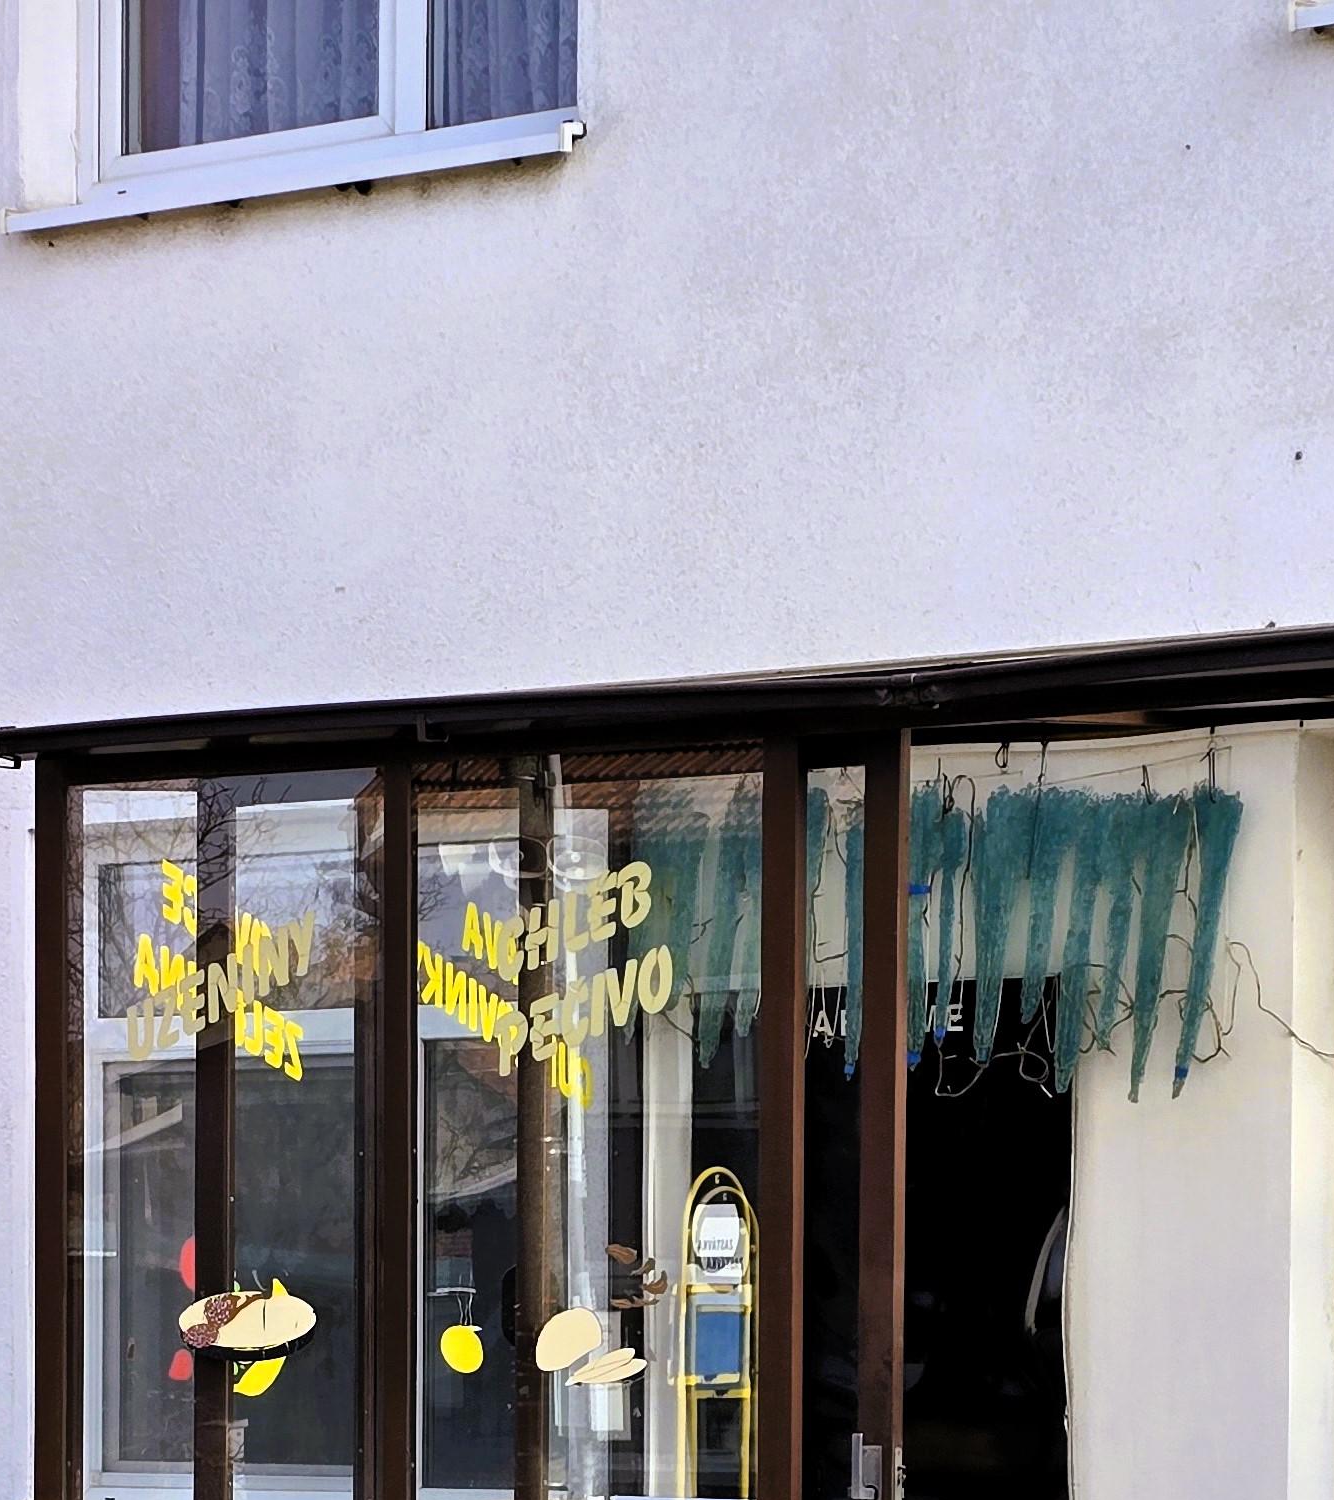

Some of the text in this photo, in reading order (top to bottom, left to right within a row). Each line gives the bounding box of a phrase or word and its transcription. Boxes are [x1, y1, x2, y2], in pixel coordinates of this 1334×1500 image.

[126, 910, 316, 1062] UZENINY
[498, 860, 653, 982] CHLÉB
[495, 944, 673, 1077] PEČIVO
